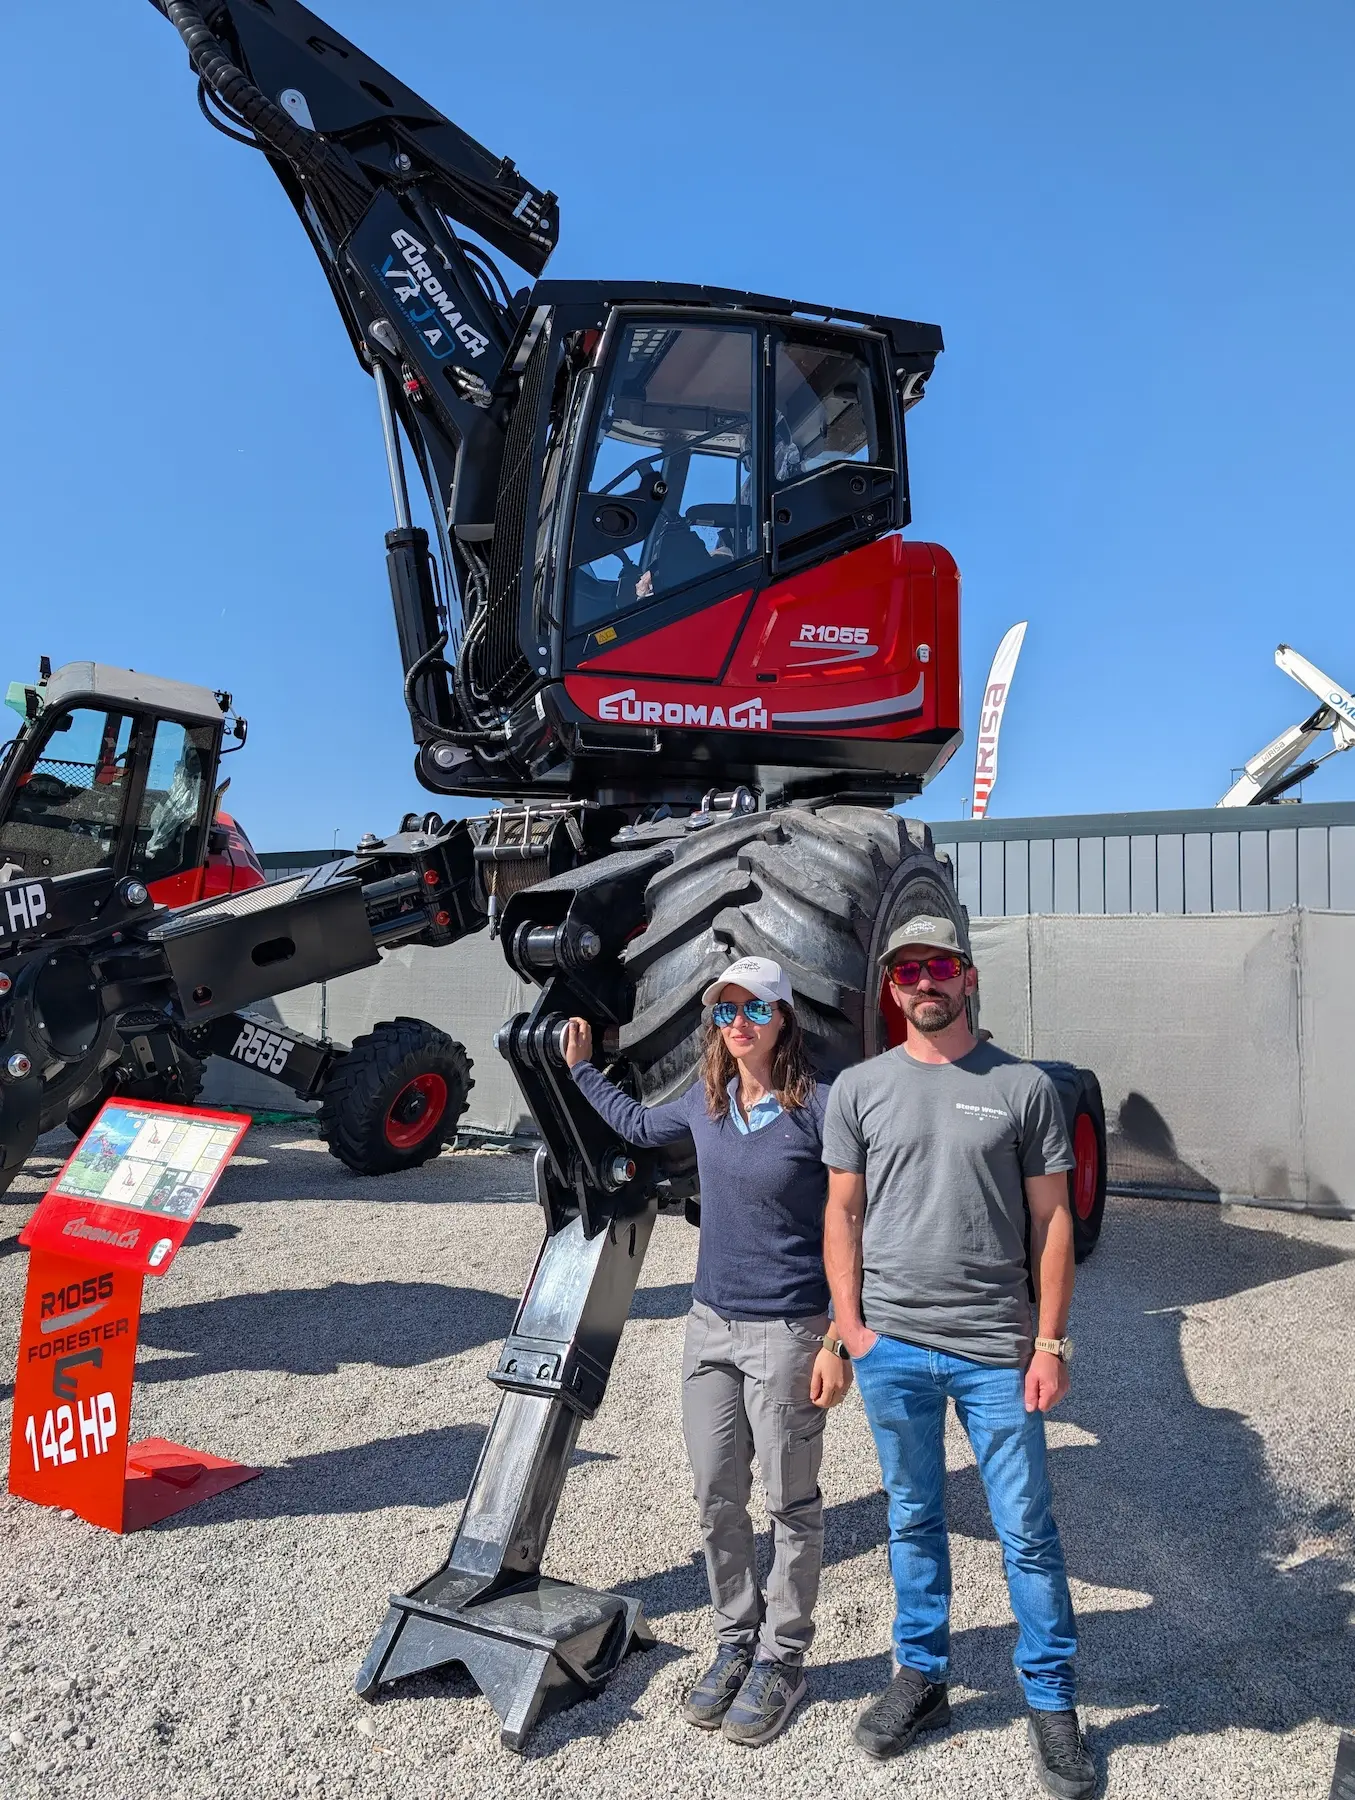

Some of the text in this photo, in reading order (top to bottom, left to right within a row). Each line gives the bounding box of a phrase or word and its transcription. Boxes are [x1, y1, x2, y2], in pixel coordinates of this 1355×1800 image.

[391, 228, 489, 359] EUROMACH
[799, 624, 870, 645] R1055
[598, 688, 768, 730] EUROMACH
[5, 883, 47, 933] HP
[229, 1023, 296, 1075] R555
[955, 1102, 1008, 1117] Steep Works
[61, 1215, 141, 1250] EUROMACH
[40, 1272, 114, 1319] R1055
[28, 1317, 129, 1364] FORESTER
[25, 1391, 117, 1473] 142 HP
